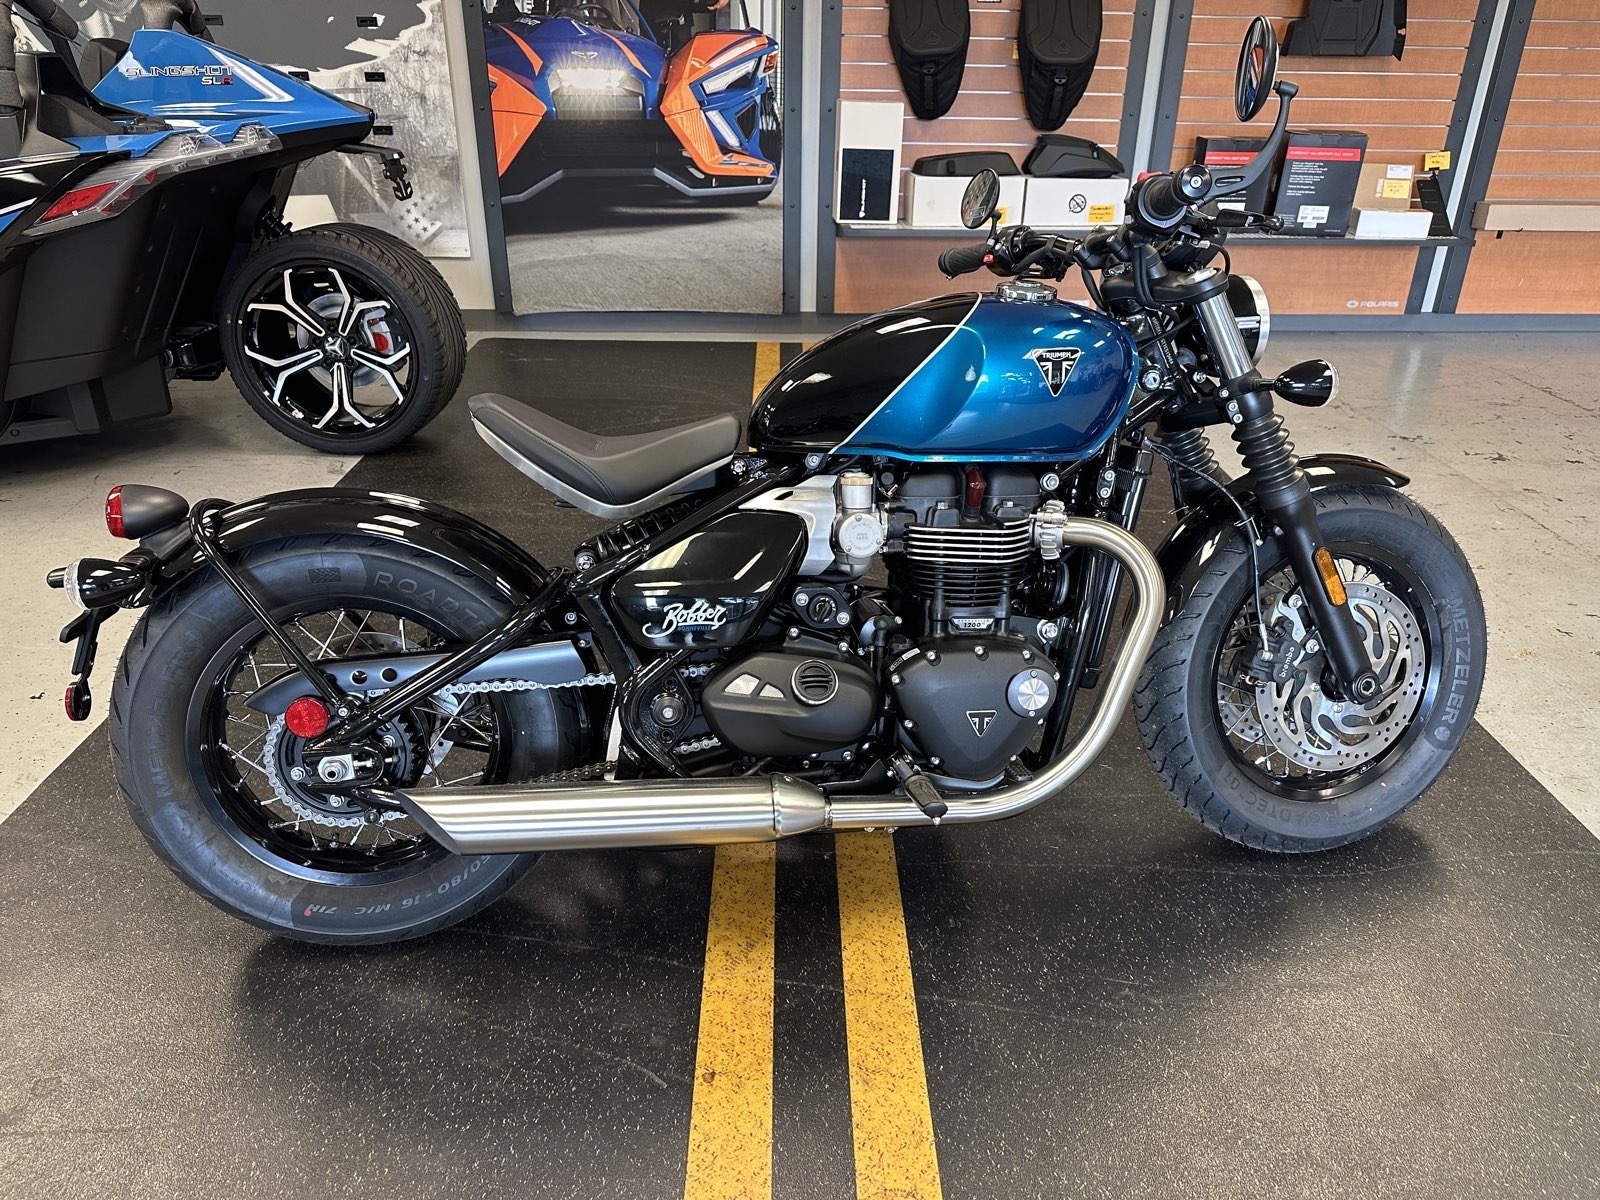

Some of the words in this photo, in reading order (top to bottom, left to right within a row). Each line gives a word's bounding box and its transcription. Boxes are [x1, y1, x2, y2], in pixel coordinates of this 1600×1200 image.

[125, 66, 234, 77] SLINGSHOT
[201, 76, 233, 86] SLR
[1360, 300, 1399, 308] POLARIS
[1042, 351, 1072, 360] TRIUMPH
[642, 600, 727, 638] Bobber
[1279, 646, 1296, 678] brembo
[1441, 597, 1471, 725] METZELER
